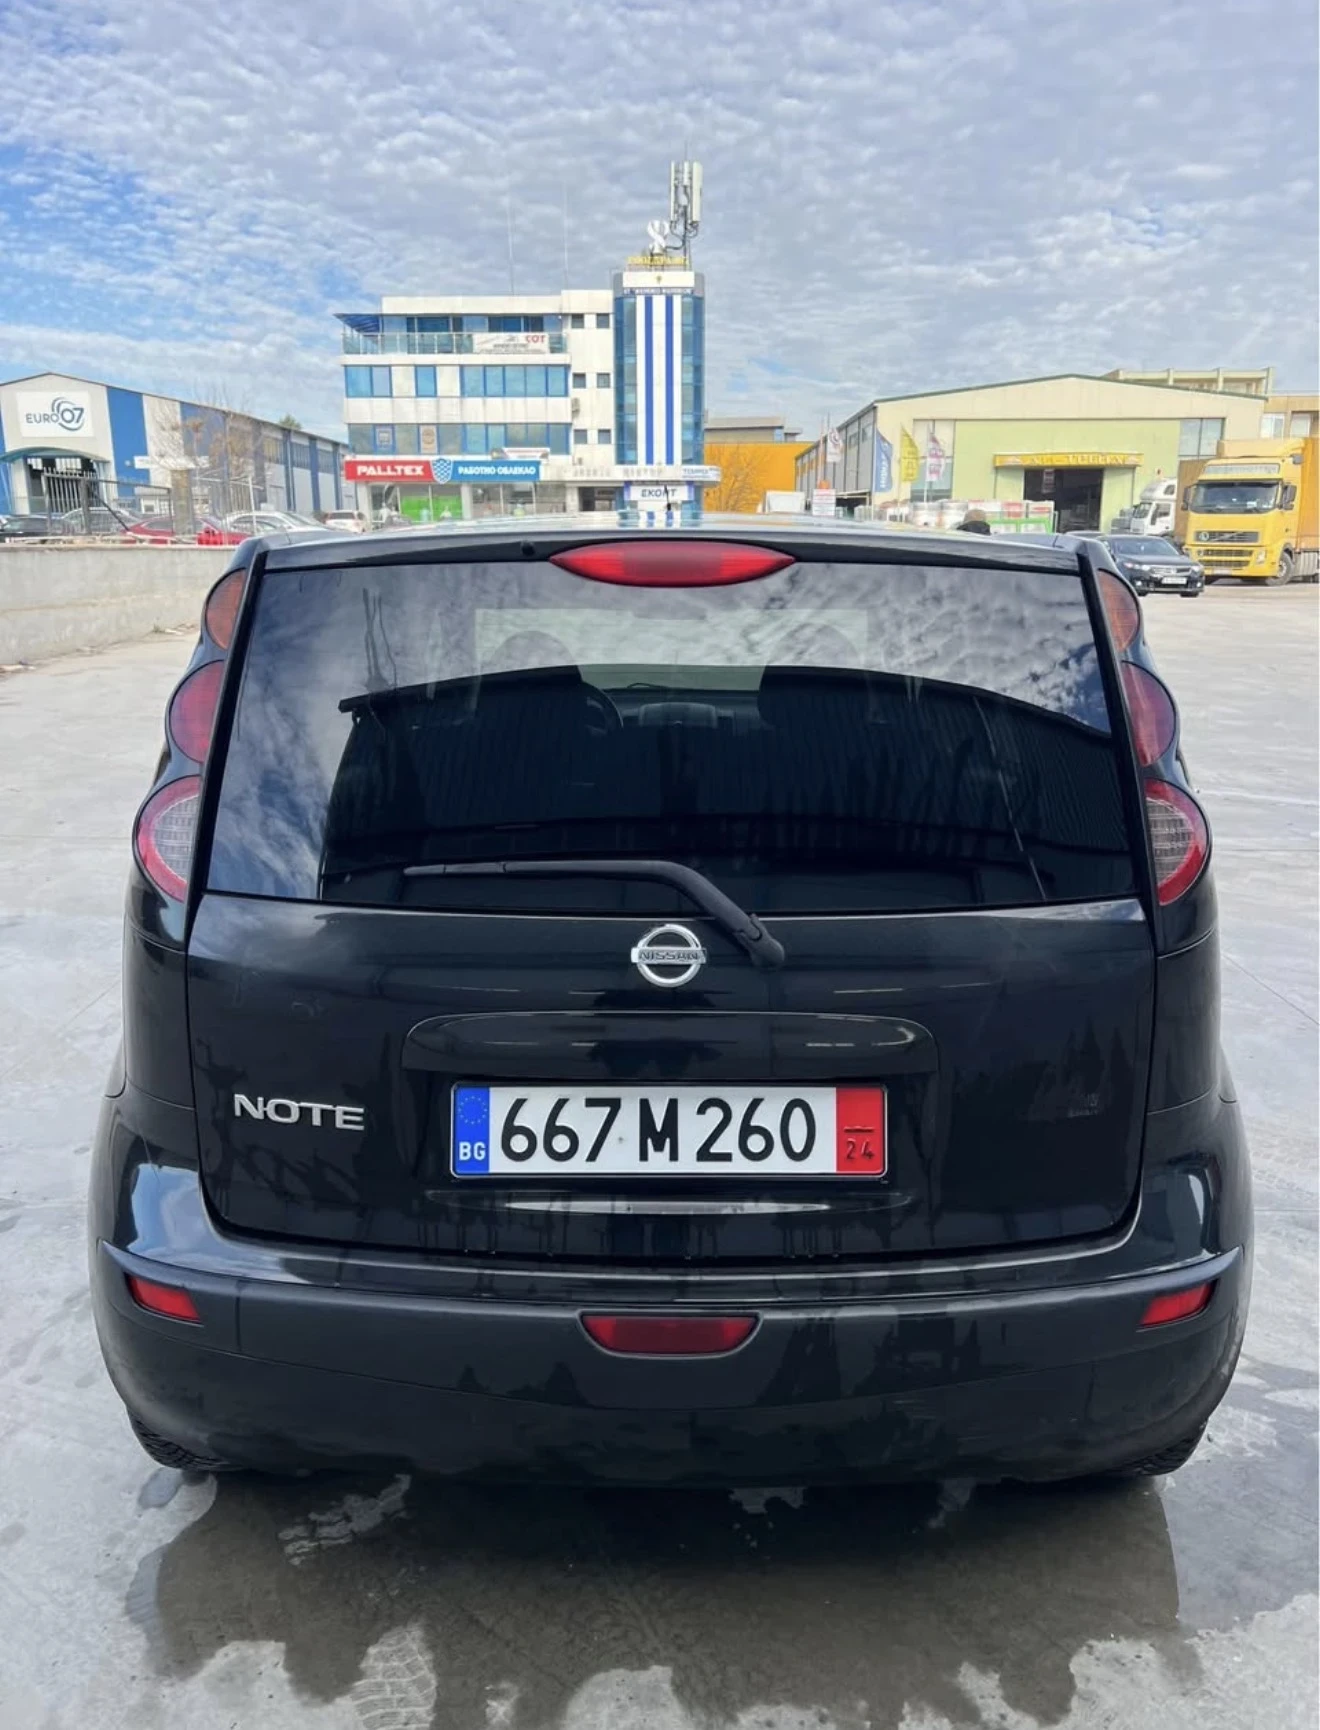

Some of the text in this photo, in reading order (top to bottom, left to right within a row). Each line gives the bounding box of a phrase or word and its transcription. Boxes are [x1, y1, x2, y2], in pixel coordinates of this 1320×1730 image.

[357, 465, 424, 476] PALLTEX
[640, 951, 698, 960] NISSAN
[234, 1093, 365, 1131] NOTE
[501, 1097, 816, 1163] 667 M 260
[459, 1141, 486, 1161] BG
[846, 1138, 875, 1160] 24
